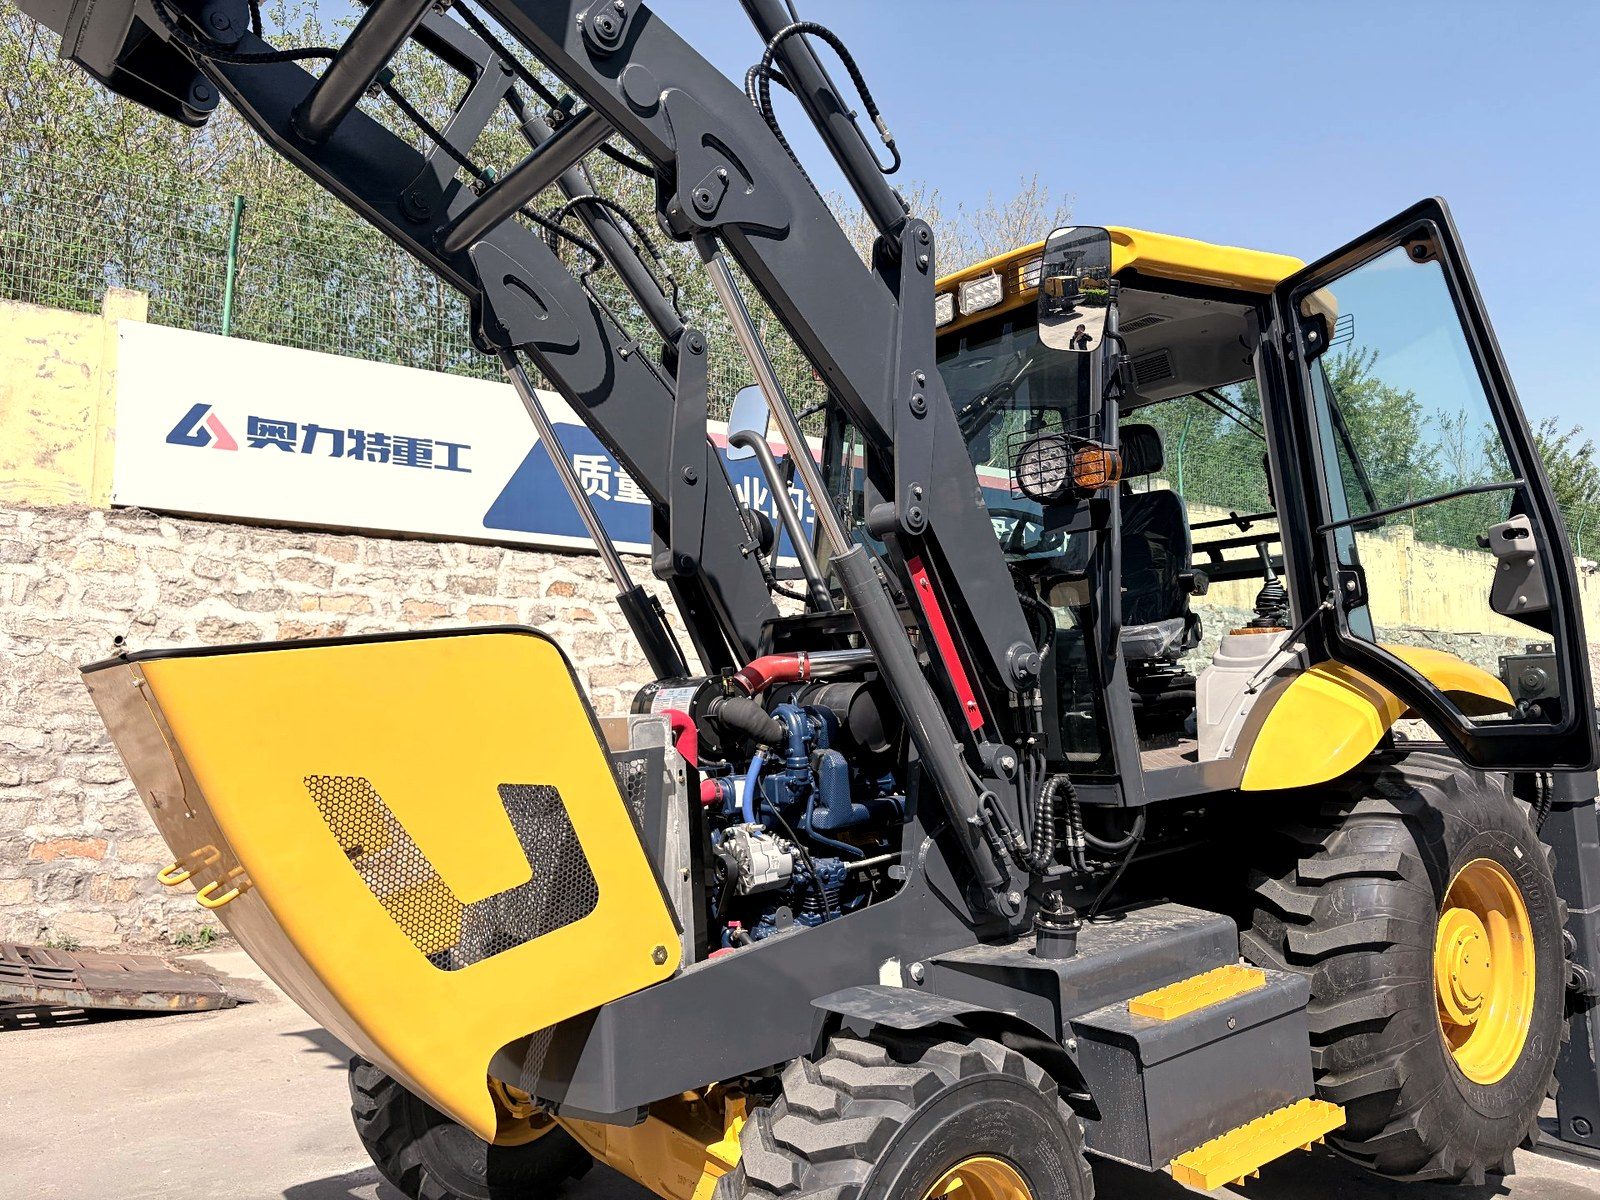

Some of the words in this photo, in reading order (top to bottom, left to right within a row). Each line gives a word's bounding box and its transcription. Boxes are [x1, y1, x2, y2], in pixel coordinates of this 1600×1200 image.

[247, 415, 472, 473] 奥力特重工
